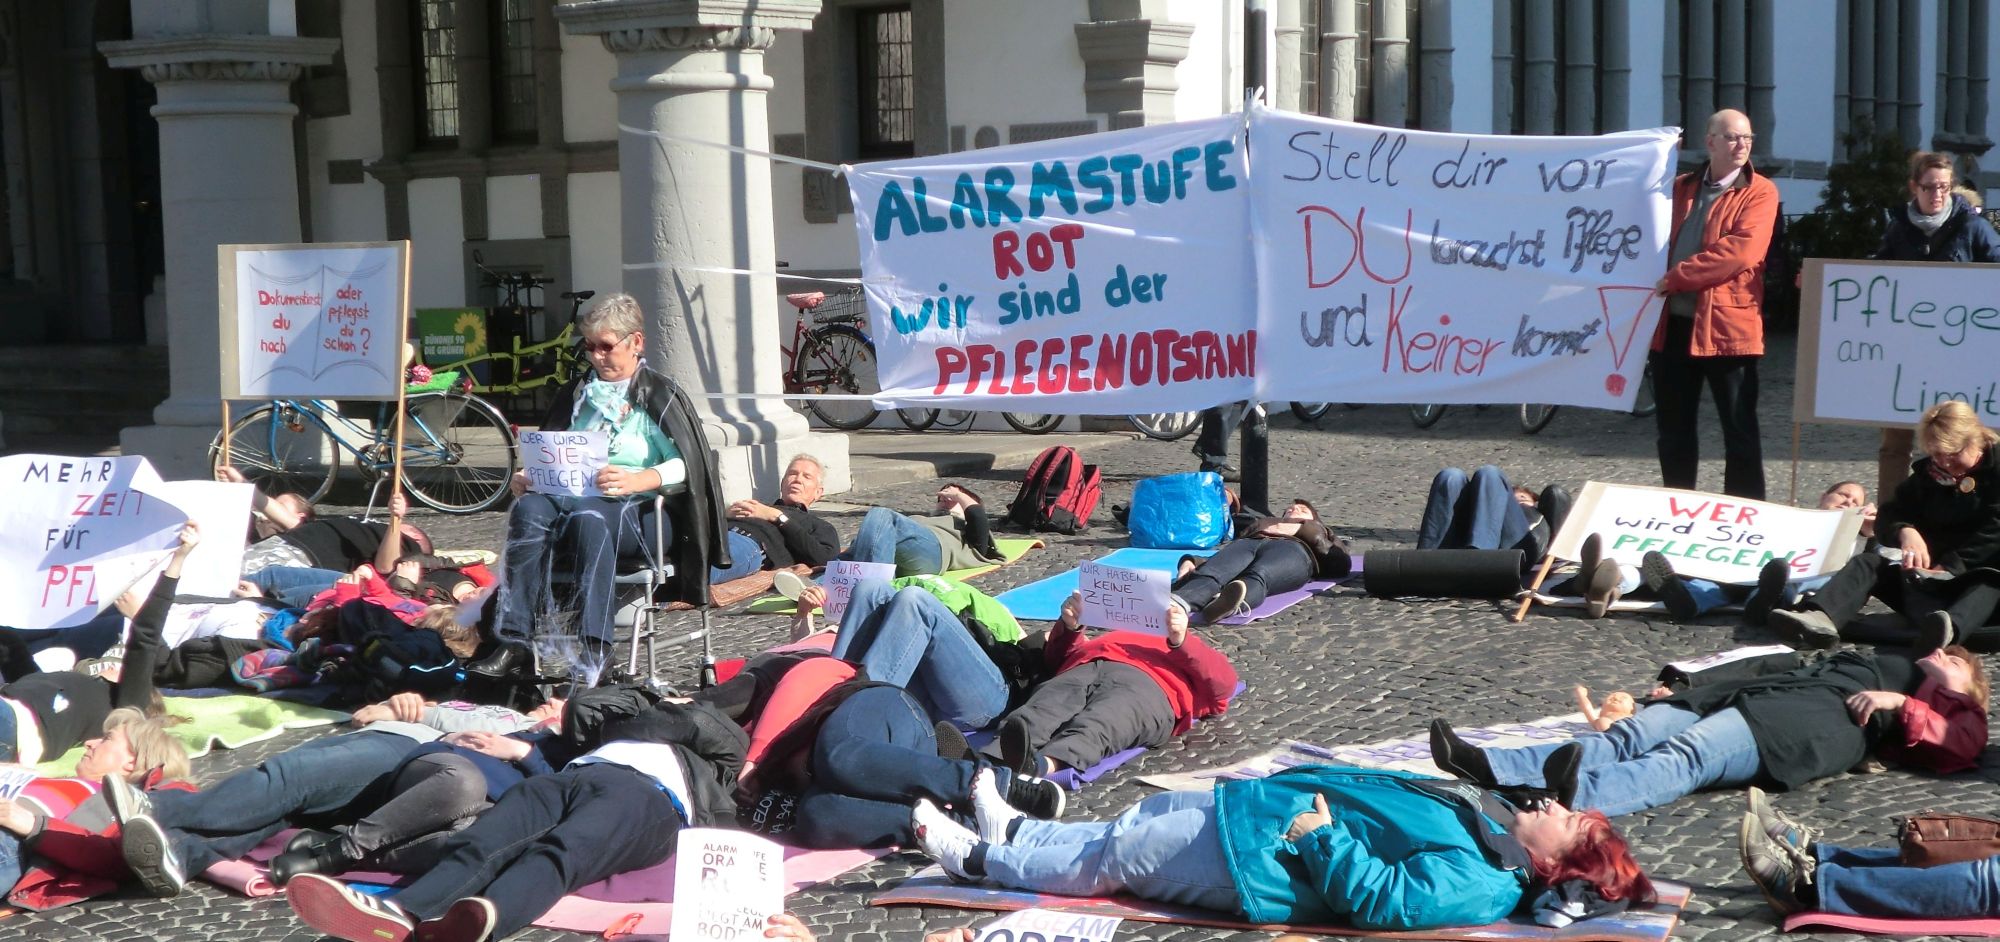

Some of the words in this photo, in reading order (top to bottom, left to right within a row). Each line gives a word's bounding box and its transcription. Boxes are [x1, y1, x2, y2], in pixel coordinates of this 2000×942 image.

[1283, 130, 1408, 187] Stell
[1431, 138, 1508, 189] dir
[1537, 157, 1618, 193] vor
[873, 139, 1237, 242] ALARMSTUFE
[992, 223, 1085, 281] ROT
[1296, 205, 1413, 290] DU
[1430, 218, 1547, 272] brauchst
[1562, 205, 1643, 274] Pflege
[336, 284, 363, 301] oder
[890, 282, 975, 335] wir
[997, 272, 1080, 325] sind
[1104, 263, 1168, 307] der
[272, 313, 291, 331] du
[329, 303, 370, 325] pflegst
[1828, 275, 2000, 347] Pflege
[340, 324, 354, 338] du
[455, 335, 465, 344] 90
[1300, 292, 1374, 349] und
[1382, 284, 1506, 377] Keiner
[260, 336, 286, 354] noch
[323, 337, 357, 352] schon
[360, 327, 372, 357] ?
[424, 345, 436, 355] DIE
[1837, 340, 1884, 362] am
[520, 432, 545, 444] WER
[553, 434, 588, 446] WIRD
[538, 446, 581, 464] SIE
[527, 466, 594, 489] PFLEGEN
[71, 489, 144, 517] ZEIT
[1669, 497, 1760, 526] WER
[1615, 516, 1696, 535] wird
[1706, 525, 1765, 546] Sie
[836, 562, 862, 576] WIR
[1080, 561, 1101, 576] WIR
[1107, 568, 1148, 583] HABEN
[1093, 578, 1133, 594] KEINE
[1083, 588, 1144, 610] ZEIT
[1105, 608, 1140, 625] MEHR
